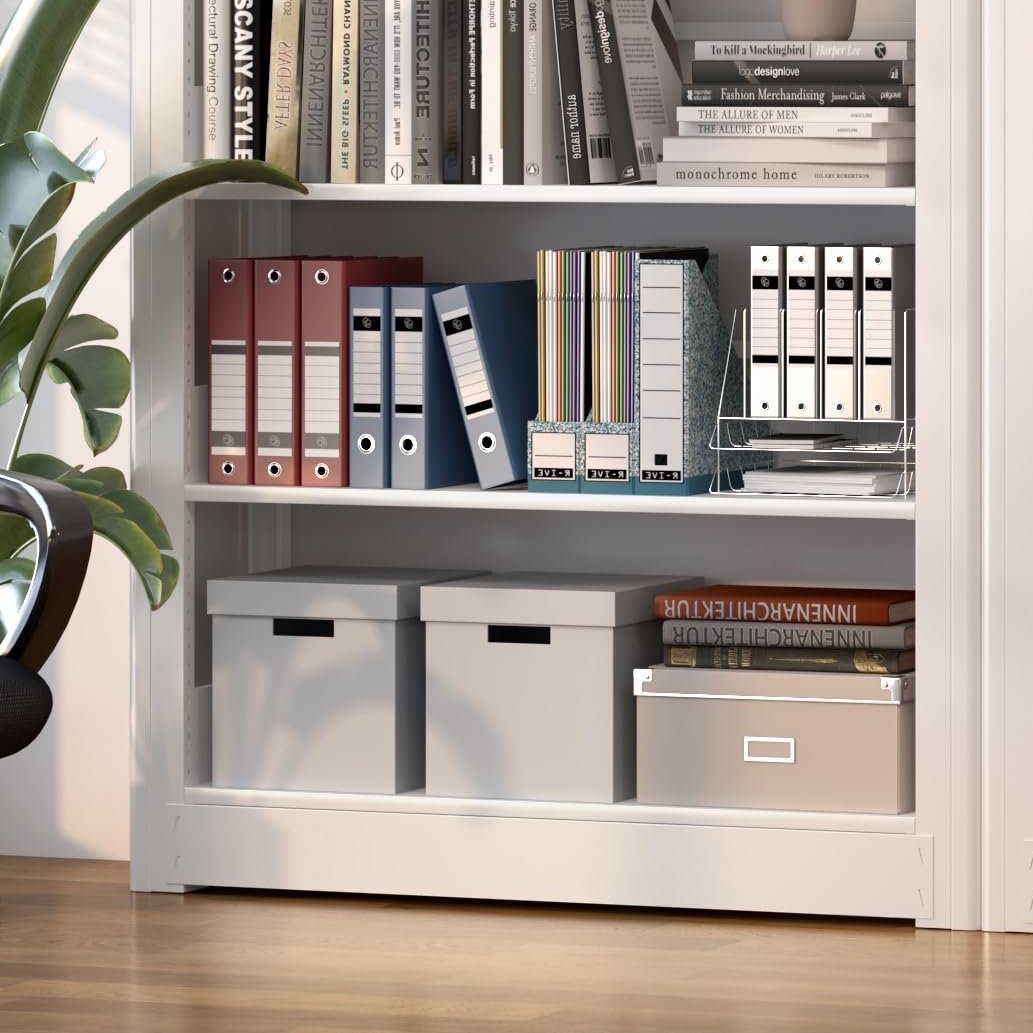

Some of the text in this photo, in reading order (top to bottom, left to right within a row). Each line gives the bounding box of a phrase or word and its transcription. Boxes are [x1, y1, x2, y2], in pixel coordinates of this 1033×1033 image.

[710, 45, 805, 57] To Kill a Mockingbird
[721, 88, 755, 101] Fashion
[758, 88, 825, 104] Merchandising
[830, 92, 849, 102] James
[849, 91, 866, 100] Clark
[698, 109, 799, 120] THE ALLURE OF MEN
[233, 85, 254, 160] STYLE
[698, 124, 804, 134] THE ALLURE OF WOMEN
[675, 168, 797, 180] monochrome home
[664, 599, 857, 623] INNENARCHITEKTUR
[673, 626, 872, 648] INNENARCHITEKTUR
